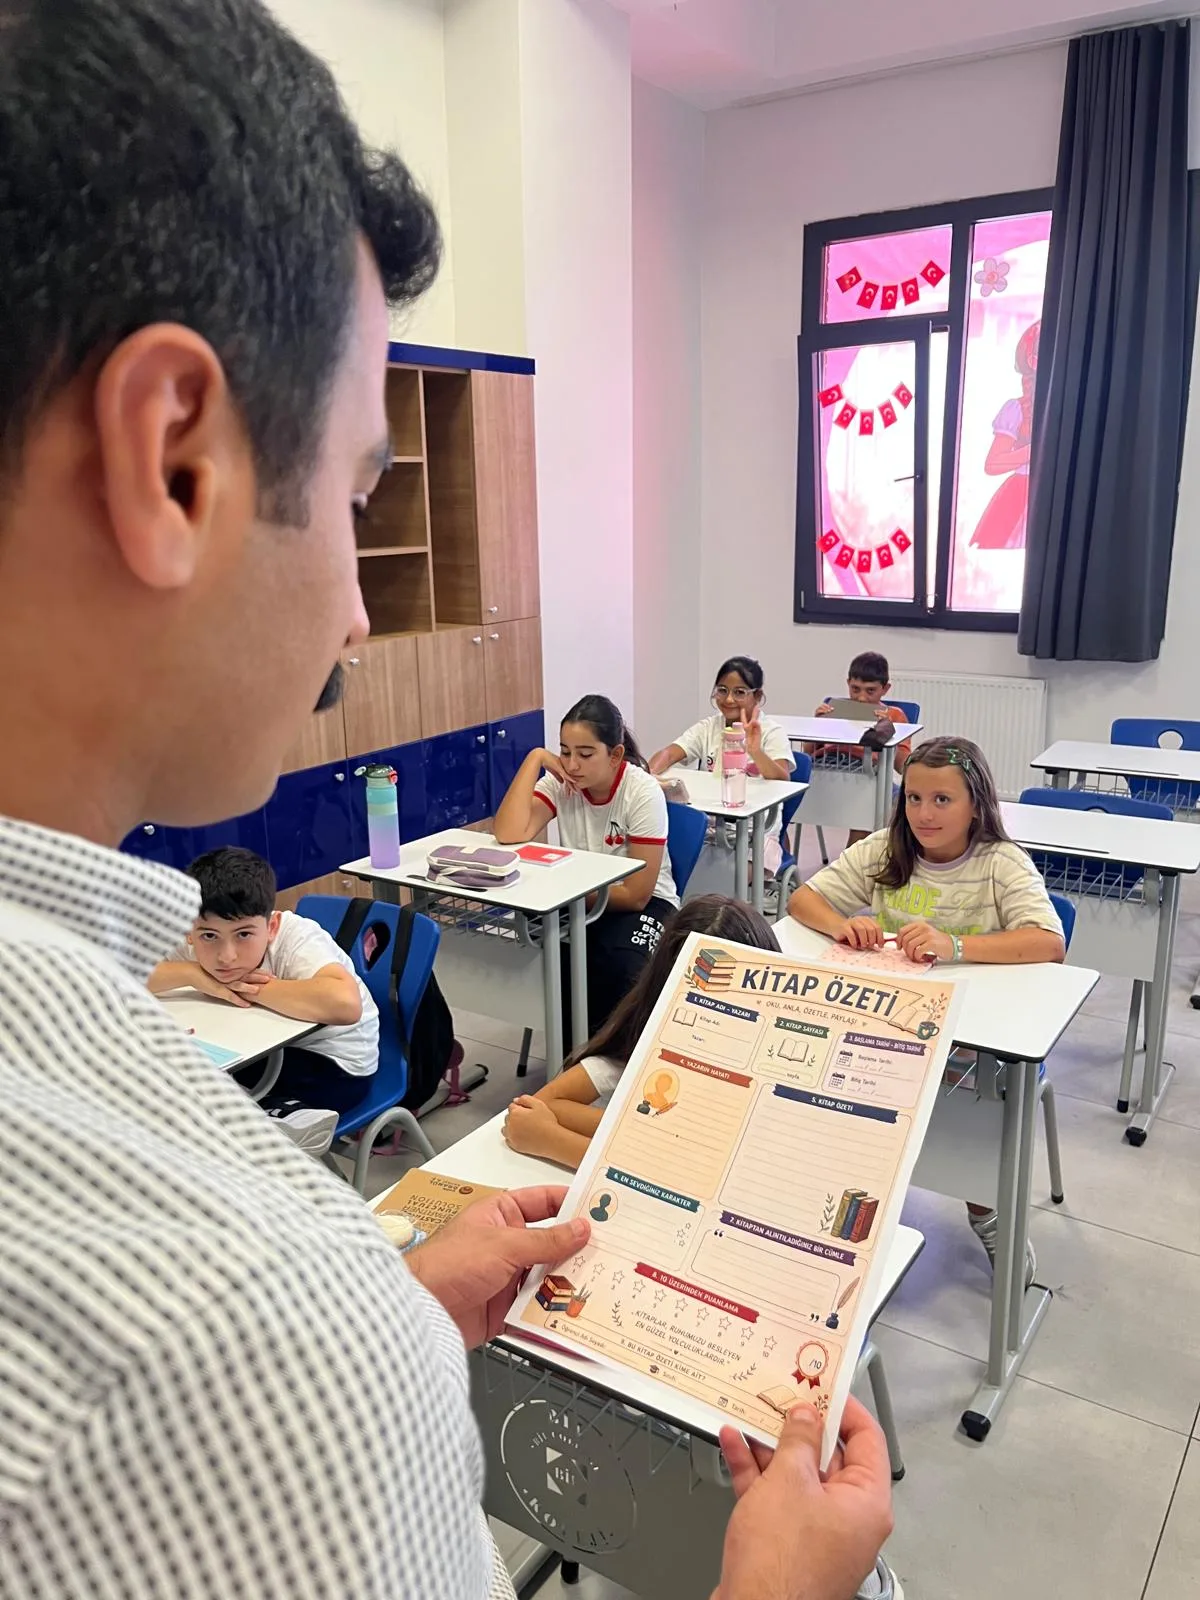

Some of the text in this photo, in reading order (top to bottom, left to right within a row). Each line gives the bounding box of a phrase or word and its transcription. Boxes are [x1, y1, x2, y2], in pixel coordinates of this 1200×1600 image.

[640, 914, 655, 925] BE
[642, 923, 661, 940] BES
[631, 936, 647, 945] OF
[741, 966, 900, 1017] KİTAP ÖZETİ
[699, 998, 715, 1007] KİTAP
[731, 1007, 751, 1018] YAZARI
[782, 1004, 801, 1013] ANLA,
[803, 1007, 829, 1019] ÖZETLE,
[786, 1021, 802, 1030] KİTAP
[802, 1025, 824, 1035] SAYFASI
[854, 1036, 875, 1044] BAŞLAMA
[894, 1042, 906, 1051] BİTİŞ
[686, 1060, 709, 1073] YAZARIN
[710, 1068, 730, 1079] HAYATI
[818, 1096, 835, 1107] KİTAP
[836, 1100, 853, 1112] ÖZETİ
[620, 1175, 629, 1183] EN
[629, 1178, 660, 1196] SEVDİĞİNİZ
[660, 1192, 691, 1207] KARAKTER
[410, 1194, 462, 1209] SOLUTION
[736, 1219, 764, 1234] KİTAPTAN
[765, 1229, 813, 1250] ALINTILADIĞINIZ
[813, 1243, 823, 1253] BİR
[824, 1248, 844, 1259] CÜMLE
[668, 1277, 703, 1298] ÜZERİNDEN
[704, 1294, 739, 1313] PUANLAMA
[635, 1320, 644, 1329] EN
[646, 1325, 665, 1338] GÜZEL
[669, 1324, 707, 1345] RUHUMUZU
[707, 1340, 742, 1360] BESLEYEN
[627, 1342, 636, 1350] BU
[637, 1345, 655, 1357] KİTAP
[655, 1353, 674, 1367] ÖZETİ
[674, 1363, 690, 1374] KİME
[690, 1370, 706, 1381] AİT?
[809, 1358, 822, 1370] /10
